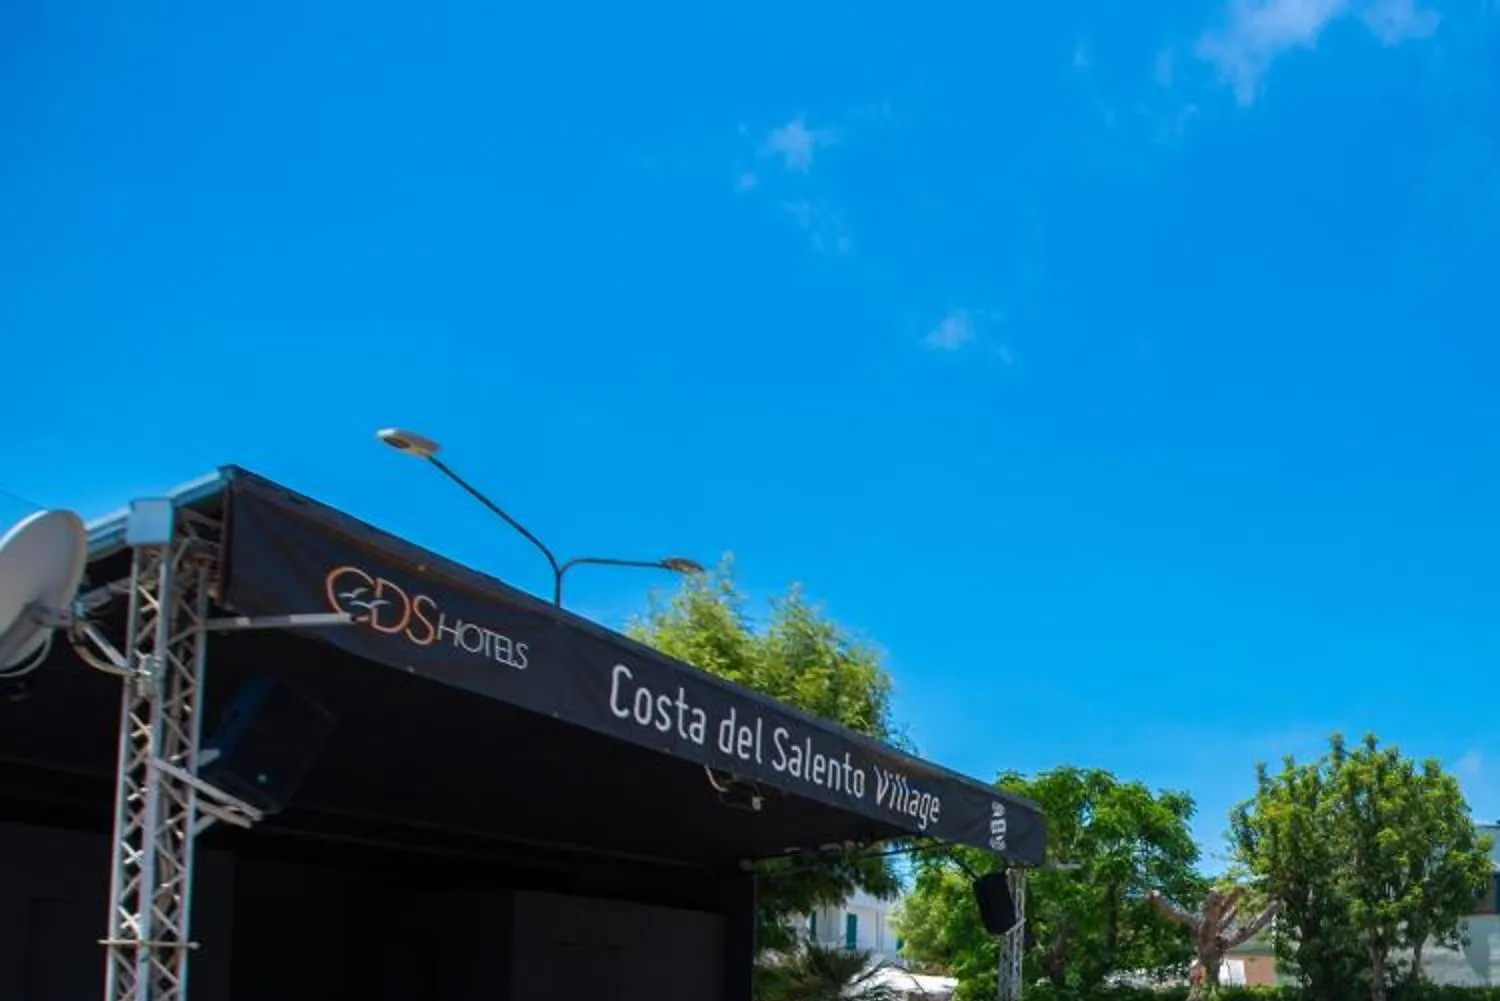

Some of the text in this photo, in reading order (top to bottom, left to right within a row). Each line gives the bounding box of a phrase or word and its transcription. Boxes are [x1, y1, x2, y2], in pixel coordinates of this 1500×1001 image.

[437, 611, 529, 670] HOTELS
[609, 664, 707, 745] Costa
[718, 706, 763, 764] del
[772, 727, 865, 798] Salento
[873, 765, 941, 831] Village
